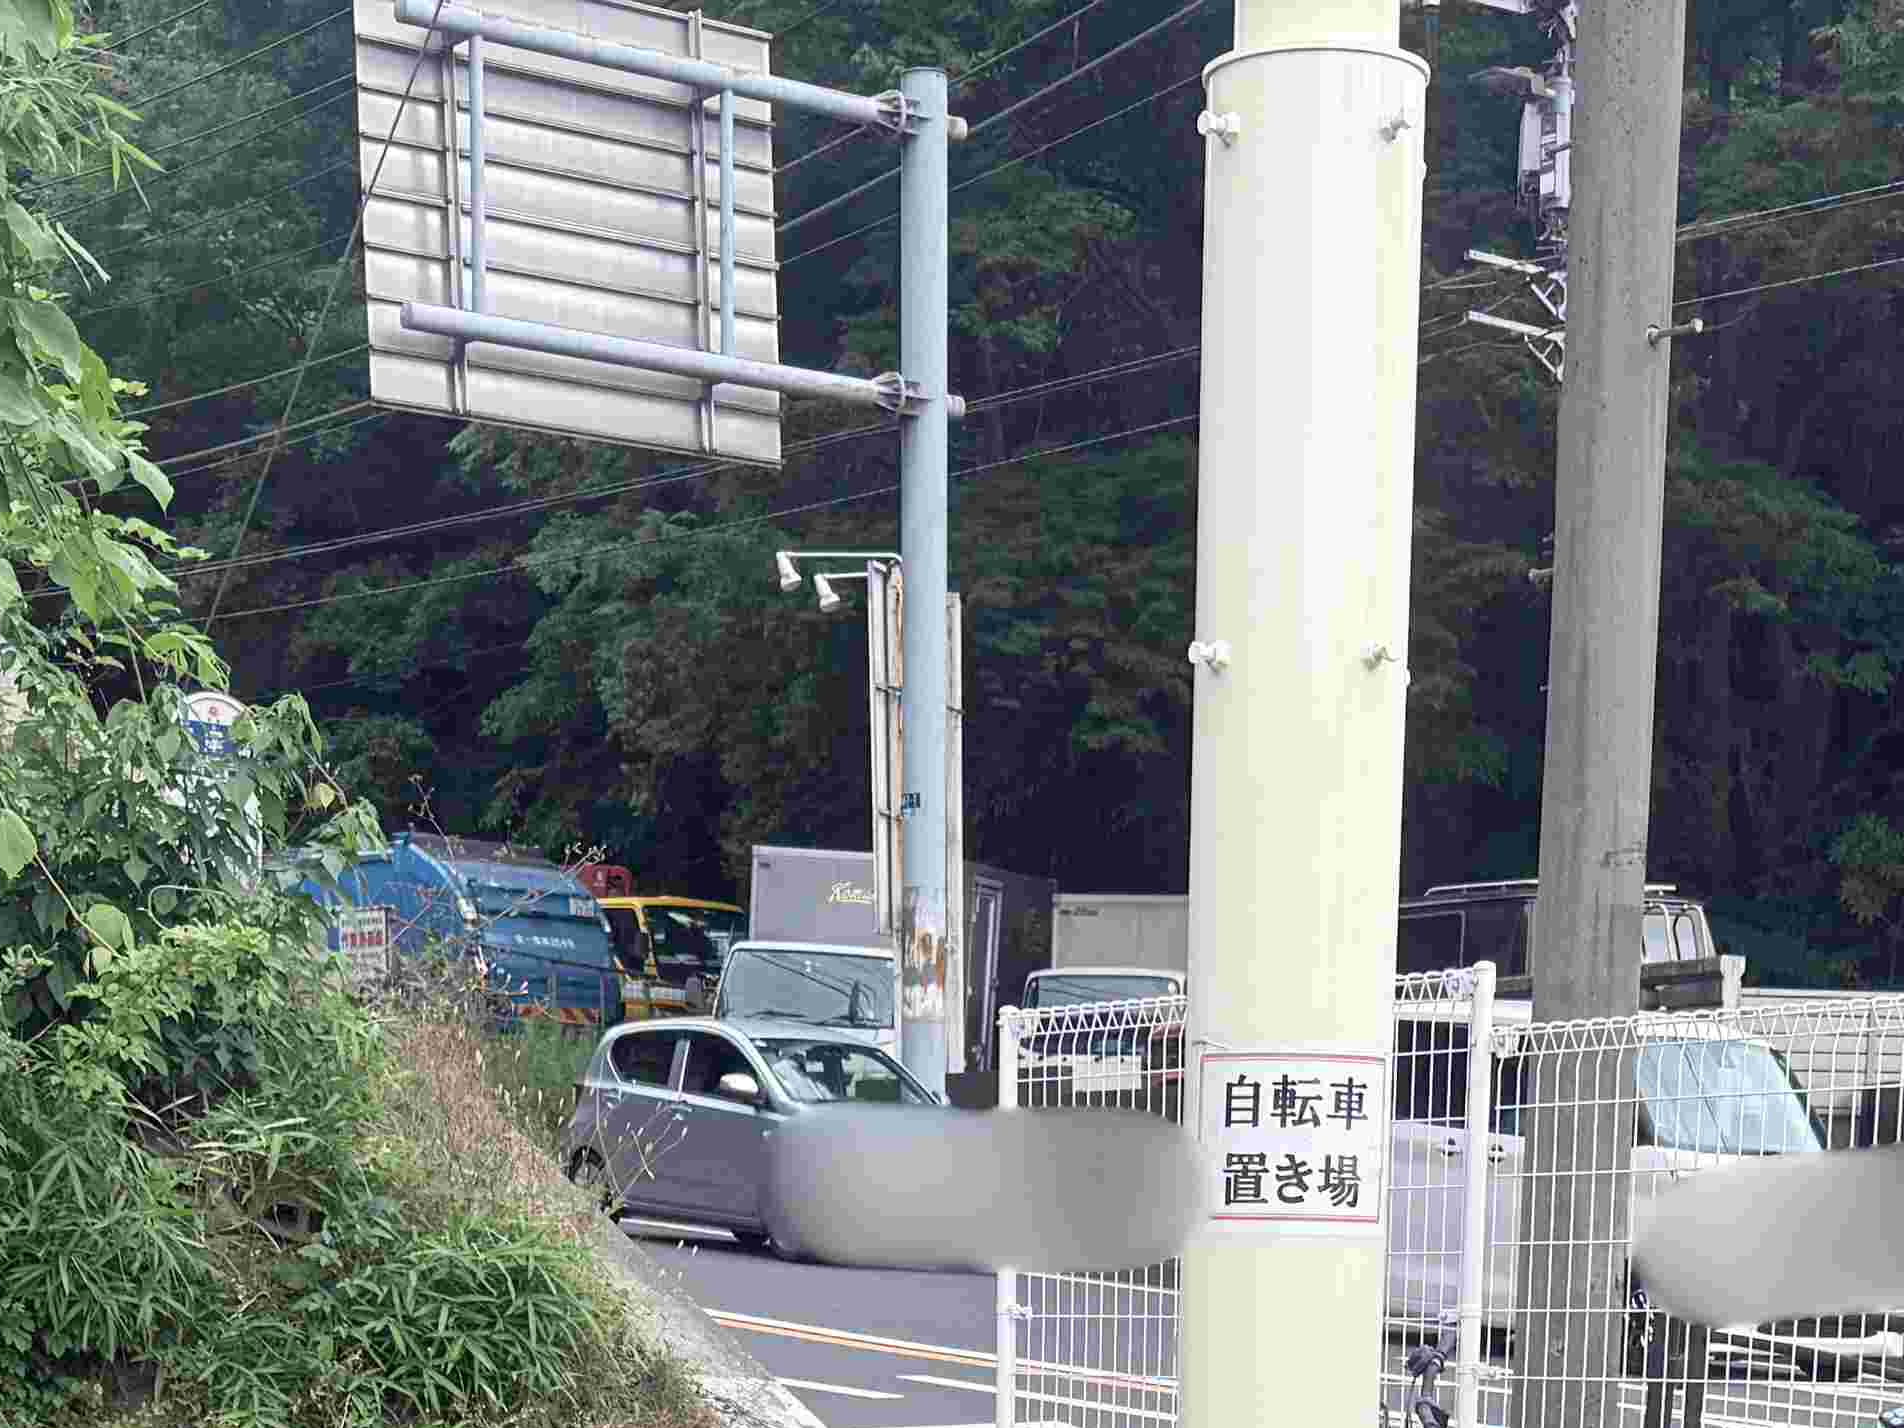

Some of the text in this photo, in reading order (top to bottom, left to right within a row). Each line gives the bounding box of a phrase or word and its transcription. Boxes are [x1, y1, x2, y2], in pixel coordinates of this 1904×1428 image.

[1224, 1074, 1368, 1130] 自転車
[1223, 1152, 1361, 1208] 置き場
